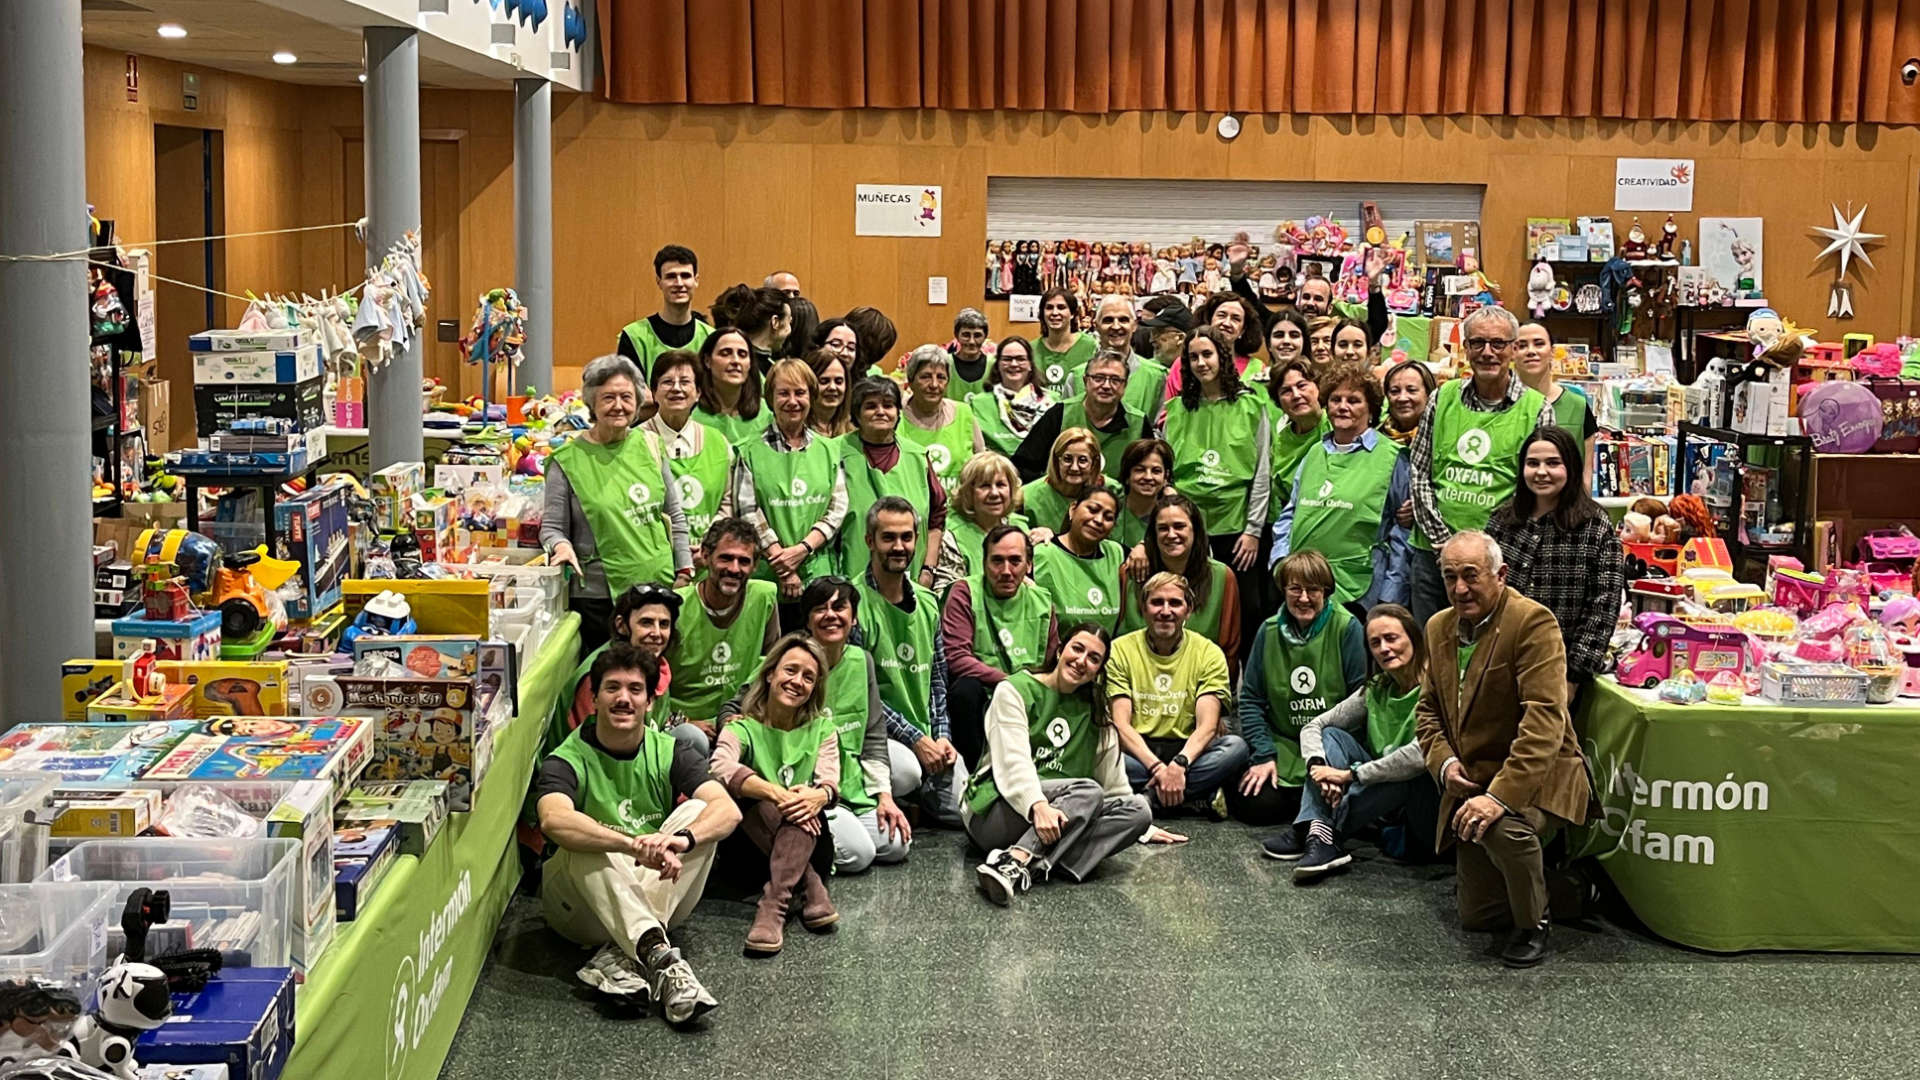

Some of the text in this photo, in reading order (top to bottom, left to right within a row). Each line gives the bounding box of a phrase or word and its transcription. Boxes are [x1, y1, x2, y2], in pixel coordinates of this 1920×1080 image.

[1618, 178, 1677, 186] CREATIVIDAD
[857, 192, 911, 203] MUÑECAS
[1445, 466, 1493, 488] OXFAM
[348, 691, 441, 705] Mechanics Kit
[1289, 697, 1327, 711] OXFAM
[1289, 714, 1314, 726] Inter
[418, 868, 472, 984] Intermón
[413, 954, 454, 1050] Oxfam
